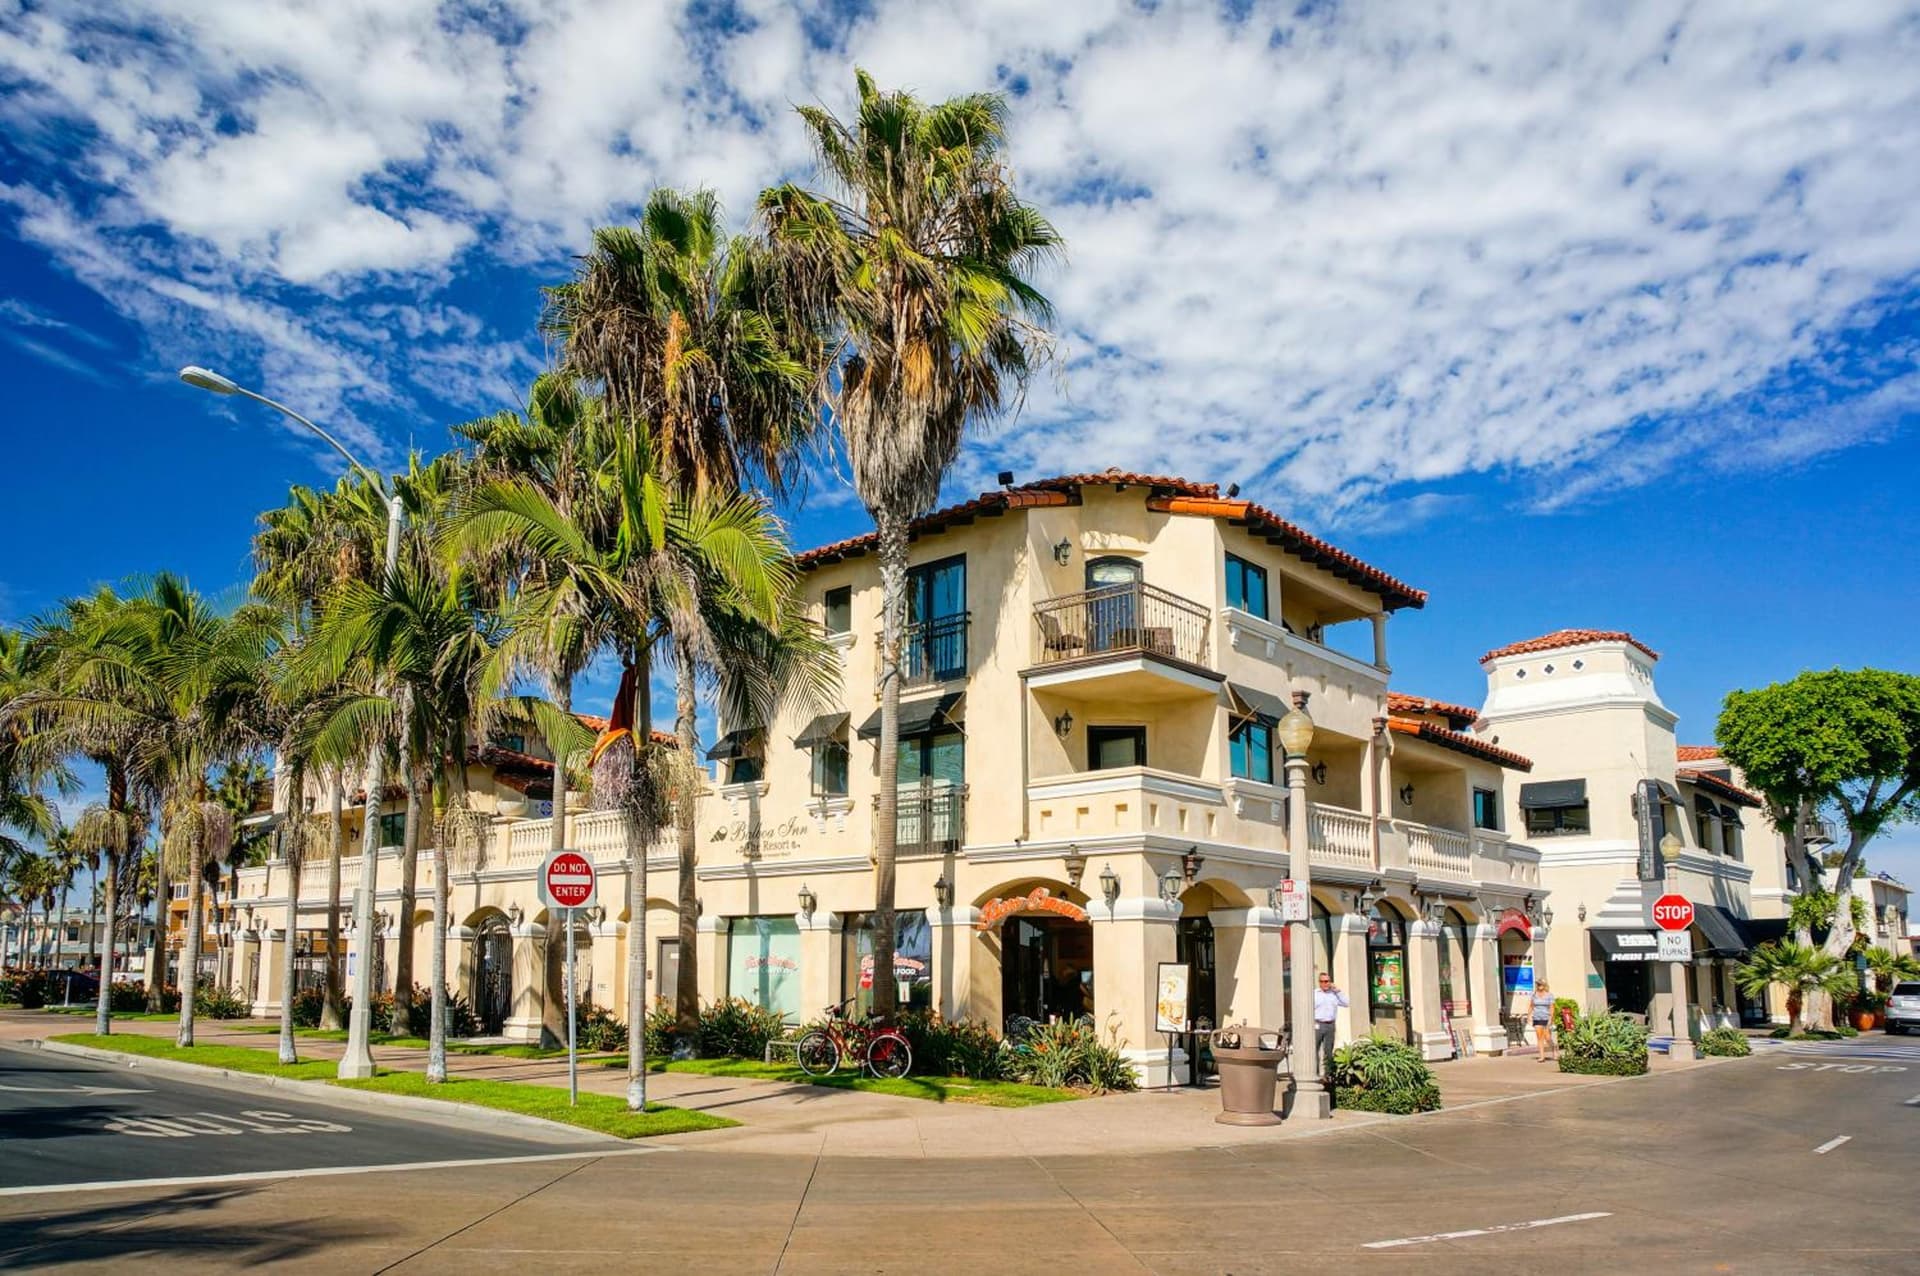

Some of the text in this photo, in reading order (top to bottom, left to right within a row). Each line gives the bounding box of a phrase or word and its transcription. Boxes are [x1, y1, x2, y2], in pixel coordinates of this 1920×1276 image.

[730, 815, 808, 841] Balboa Inn
[763, 840, 790, 851] Resort
[553, 863, 587, 873] DO NOT
[555, 886, 586, 897] ENTER
[1655, 905, 1691, 920] STOP
[1667, 936, 1682, 946] NO
[1661, 948, 1689, 957] TURNS
[1776, 1062, 1908, 1074] STOP
